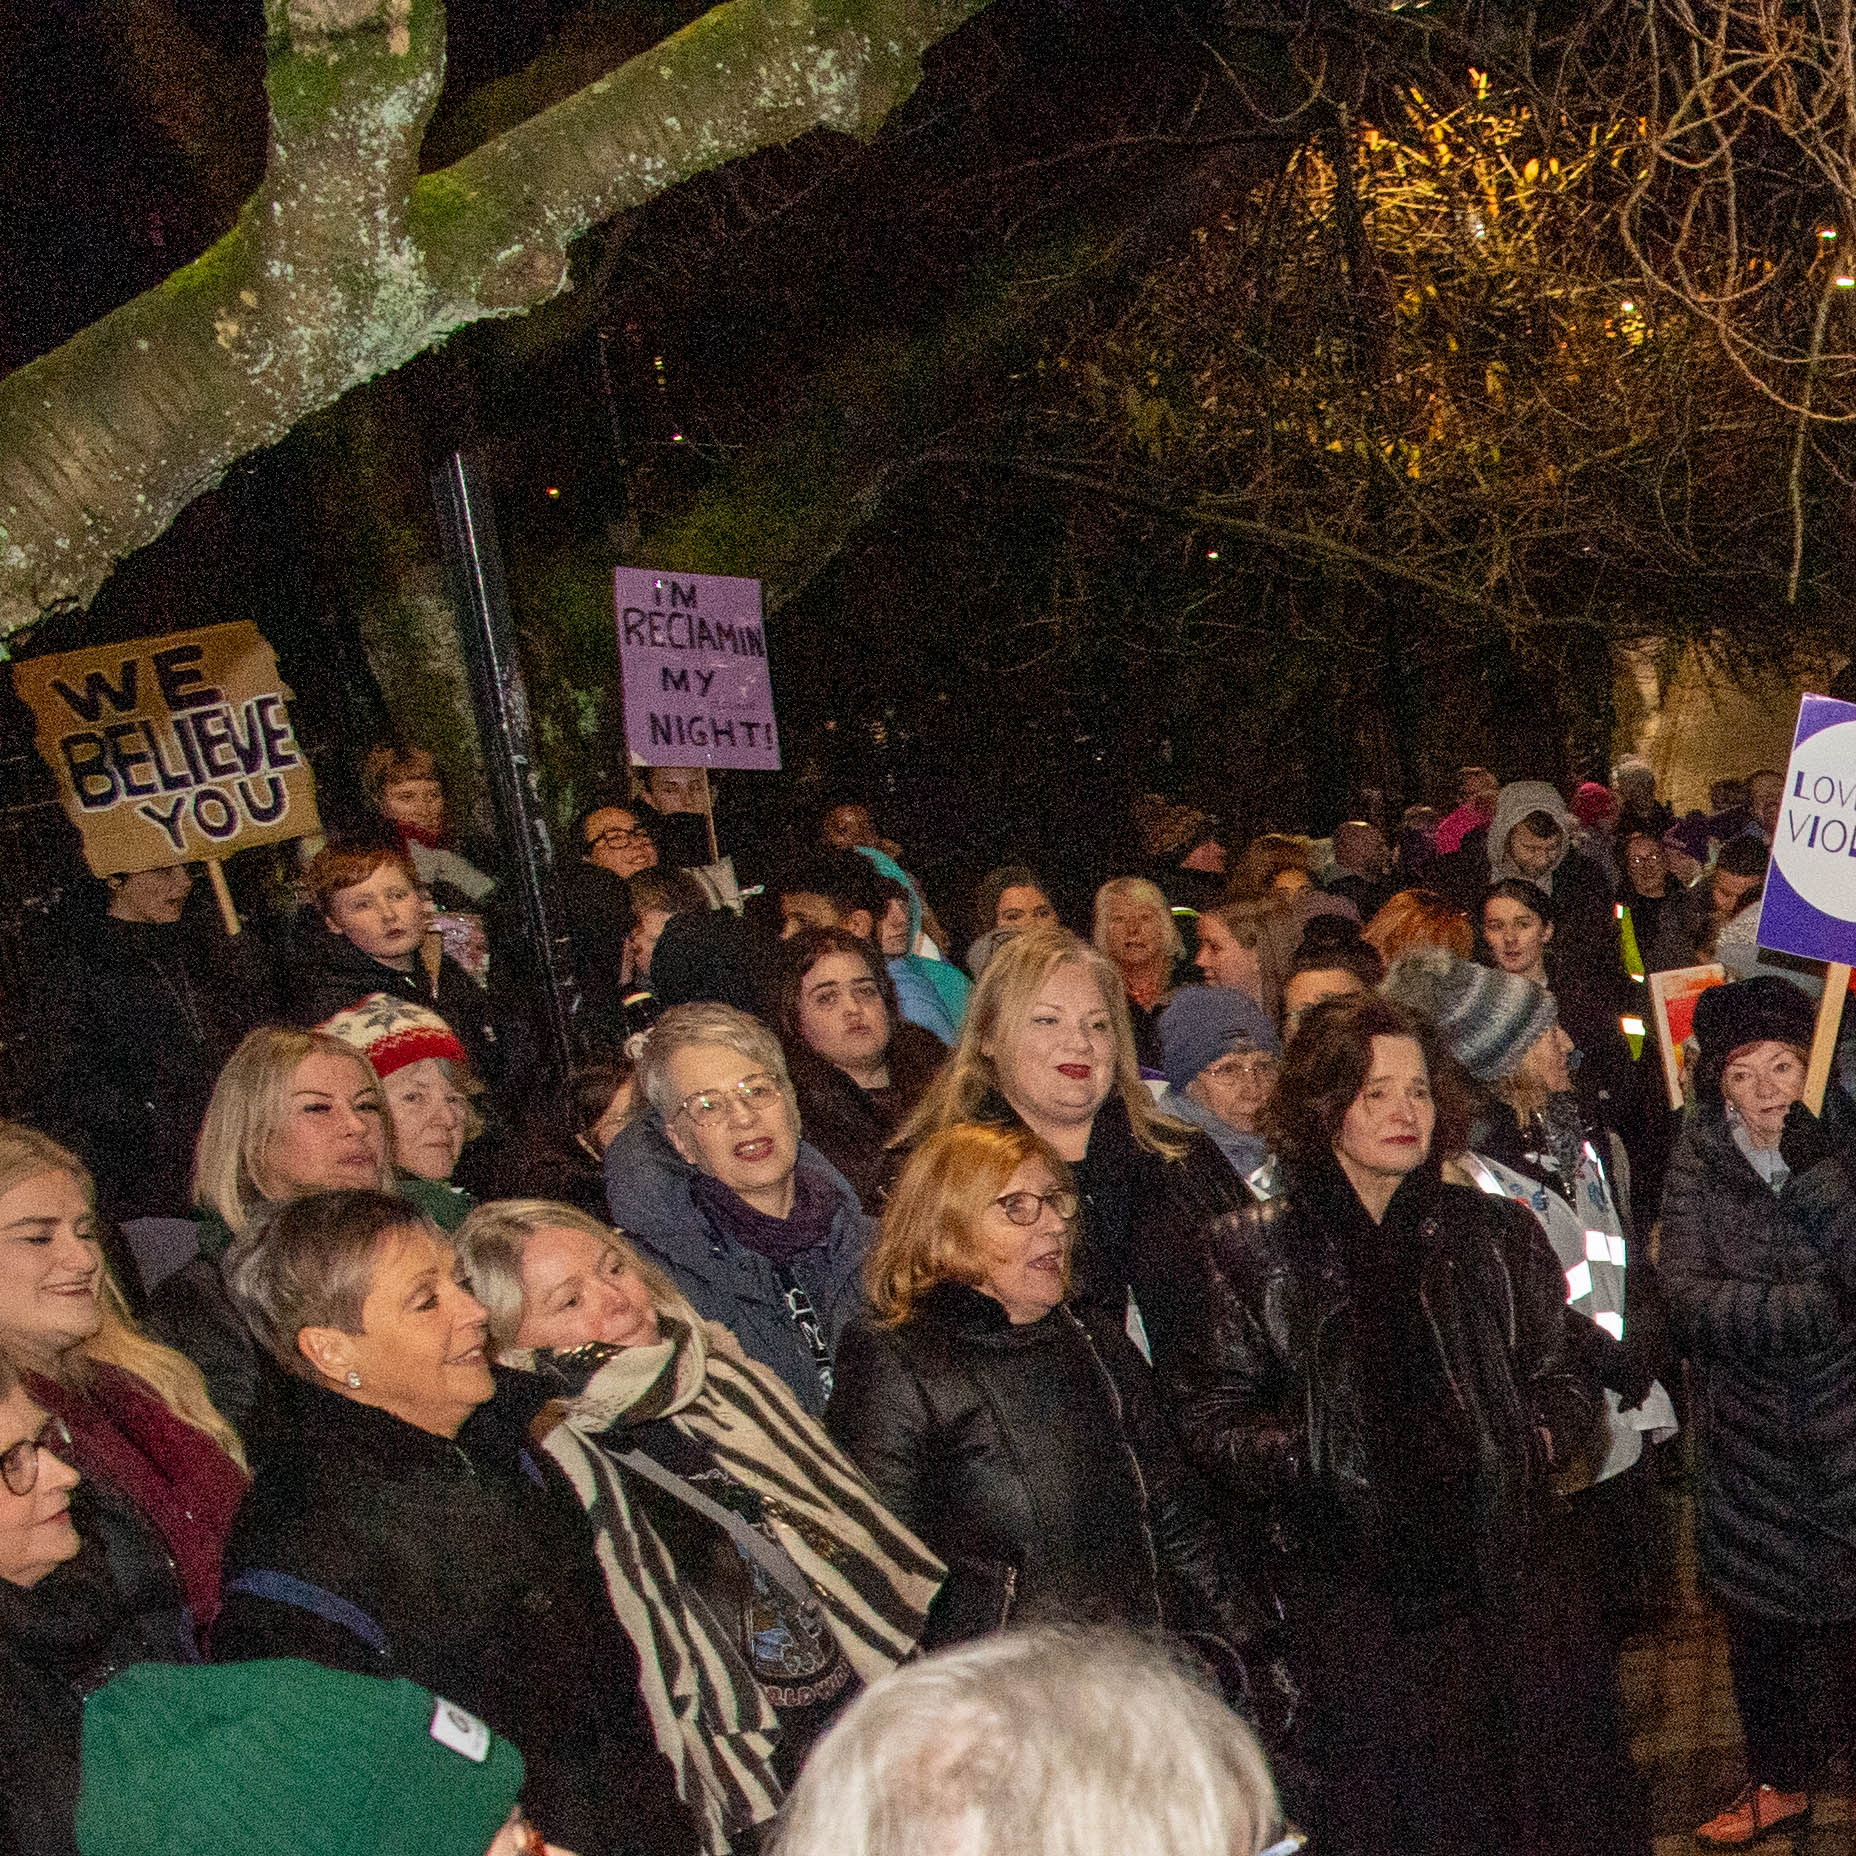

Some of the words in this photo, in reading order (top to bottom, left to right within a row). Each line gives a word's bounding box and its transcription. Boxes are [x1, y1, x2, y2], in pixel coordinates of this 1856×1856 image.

[52, 645, 224, 722] WE
[660, 666, 715, 698] MY
[60, 693, 300, 811] BELIEVE
[650, 712, 774, 751] NIGHT!
[138, 775, 288, 851] YOU
